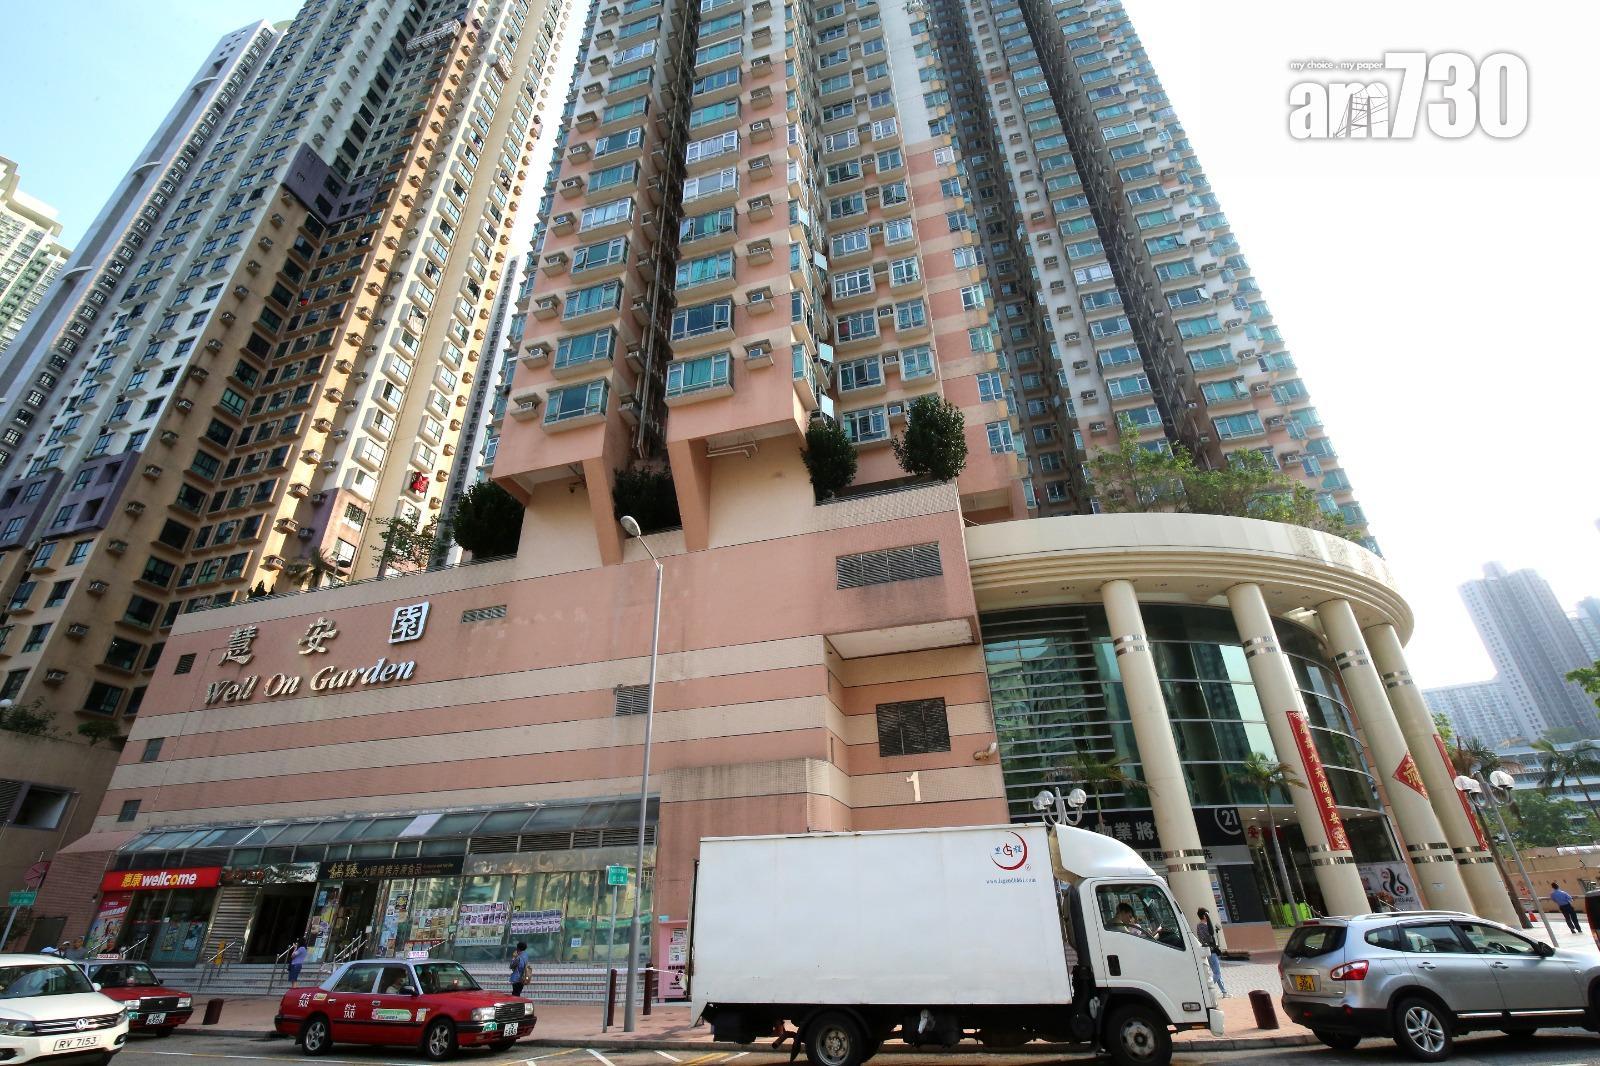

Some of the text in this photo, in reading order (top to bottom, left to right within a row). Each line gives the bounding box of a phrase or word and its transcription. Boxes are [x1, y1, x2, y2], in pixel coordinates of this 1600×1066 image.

[205, 657, 417, 705] Well On Garden
[906, 771, 921, 801] 1
[1221, 809, 1240, 826] 21
[121, 871, 197, 888] 惠康 wellcome
[59, 1037, 97, 1049] RV 7153
